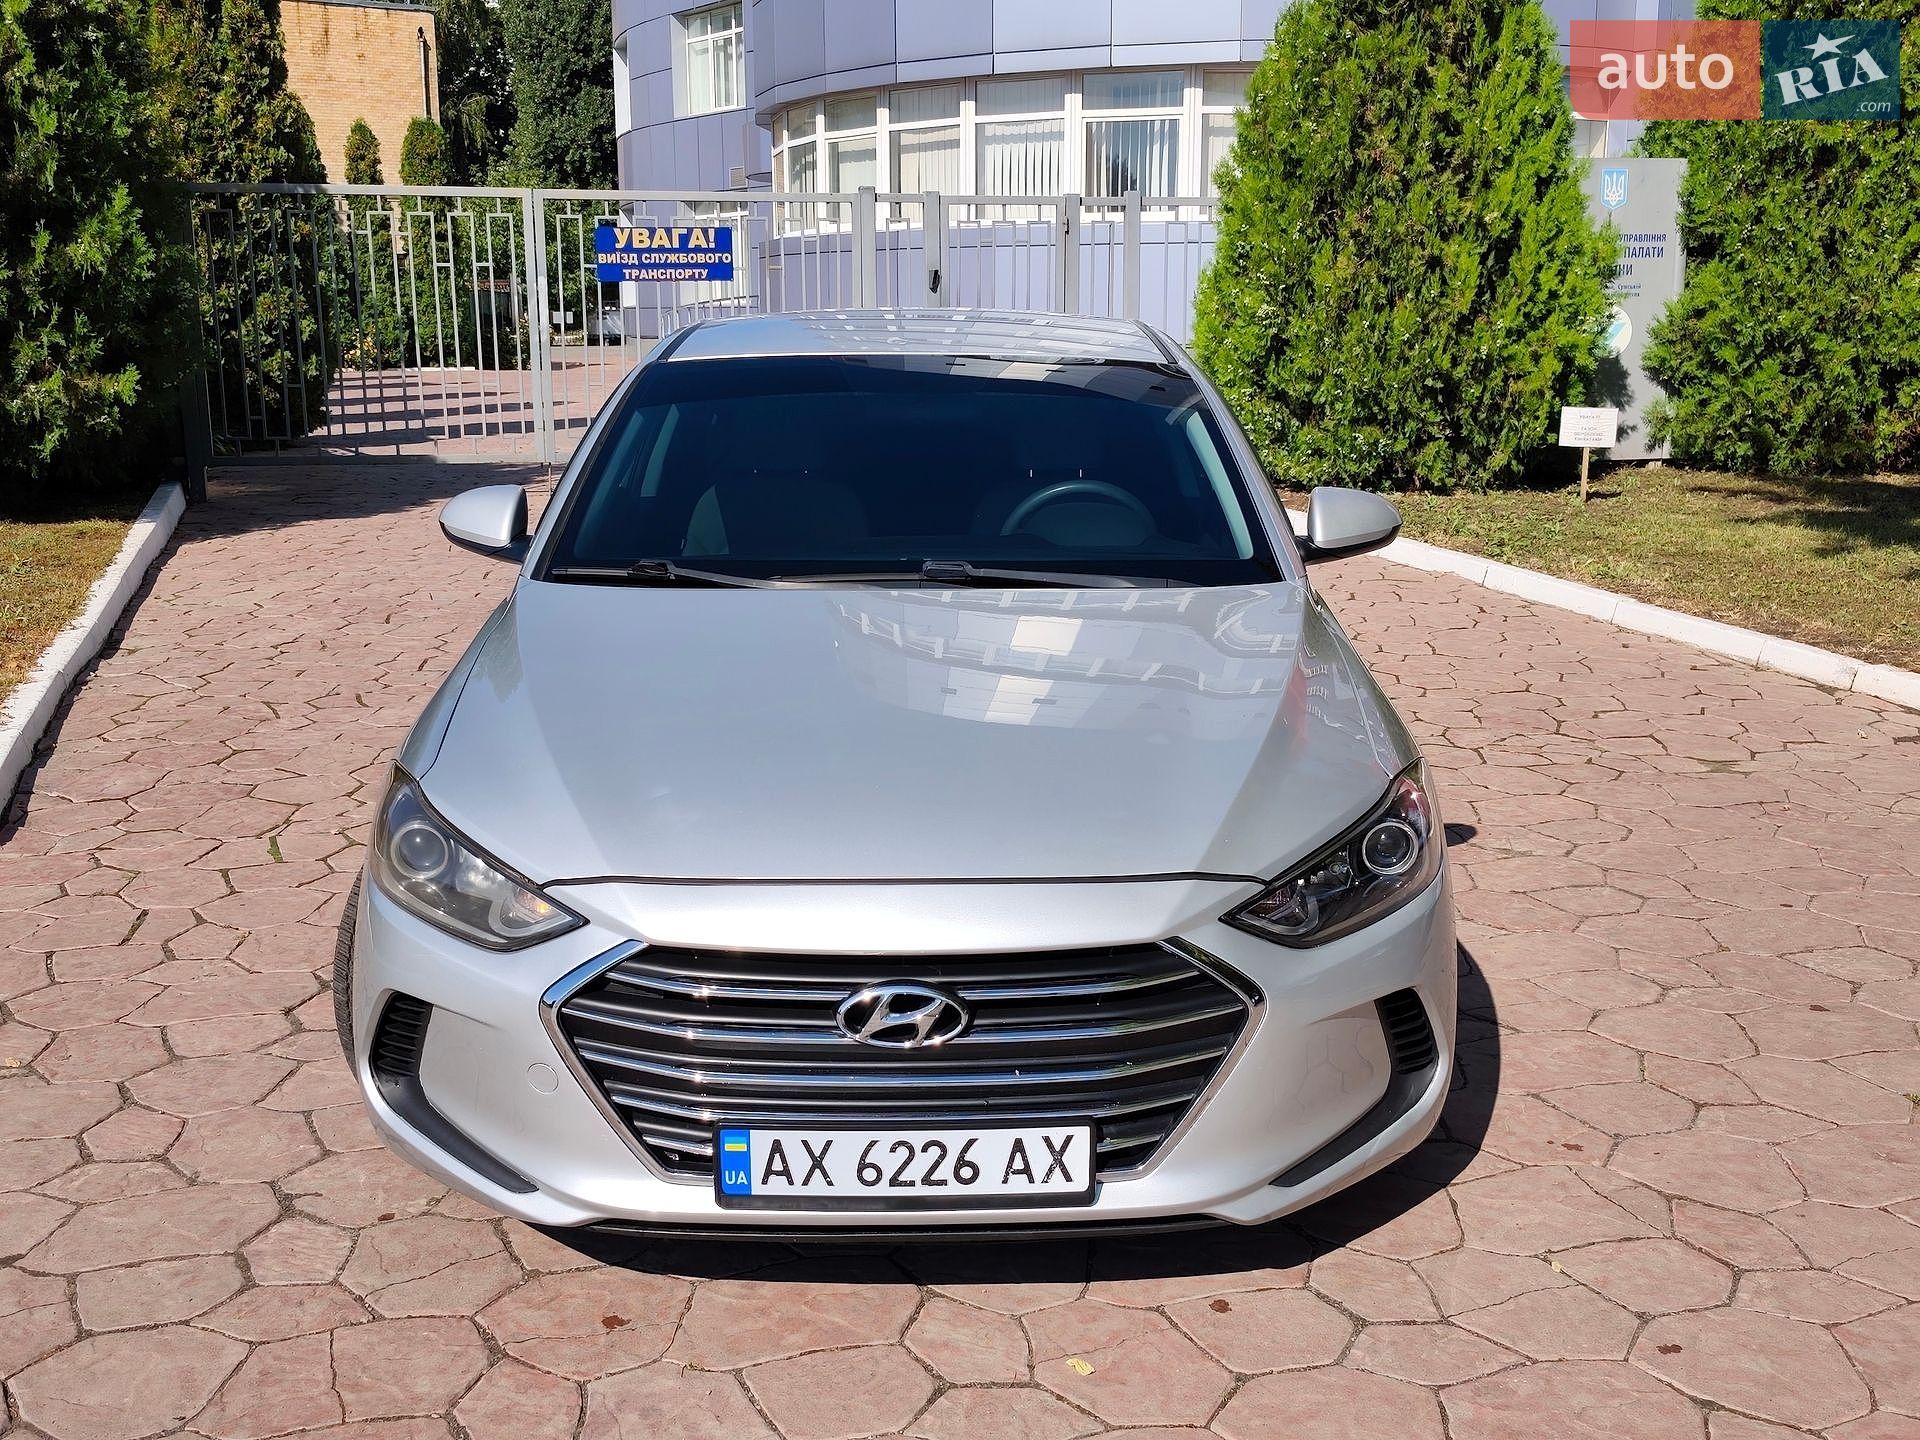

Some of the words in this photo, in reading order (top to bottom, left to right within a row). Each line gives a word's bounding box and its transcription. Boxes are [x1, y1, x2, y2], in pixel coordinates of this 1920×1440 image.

[613, 228, 716, 249] УВАГА!
[599, 252, 639, 265] ВИЇЗД
[641, 253, 732, 264] СЛУЖБОВОГО
[1624, 246, 1664, 258] ПАЛАТИ
[623, 269, 708, 280] ТРАНСПОРТУ
[761, 1139, 834, 1186] AX
[856, 1138, 980, 1187] 6226
[1002, 1135, 1075, 1184] AX
[725, 1171, 748, 1185] UA
